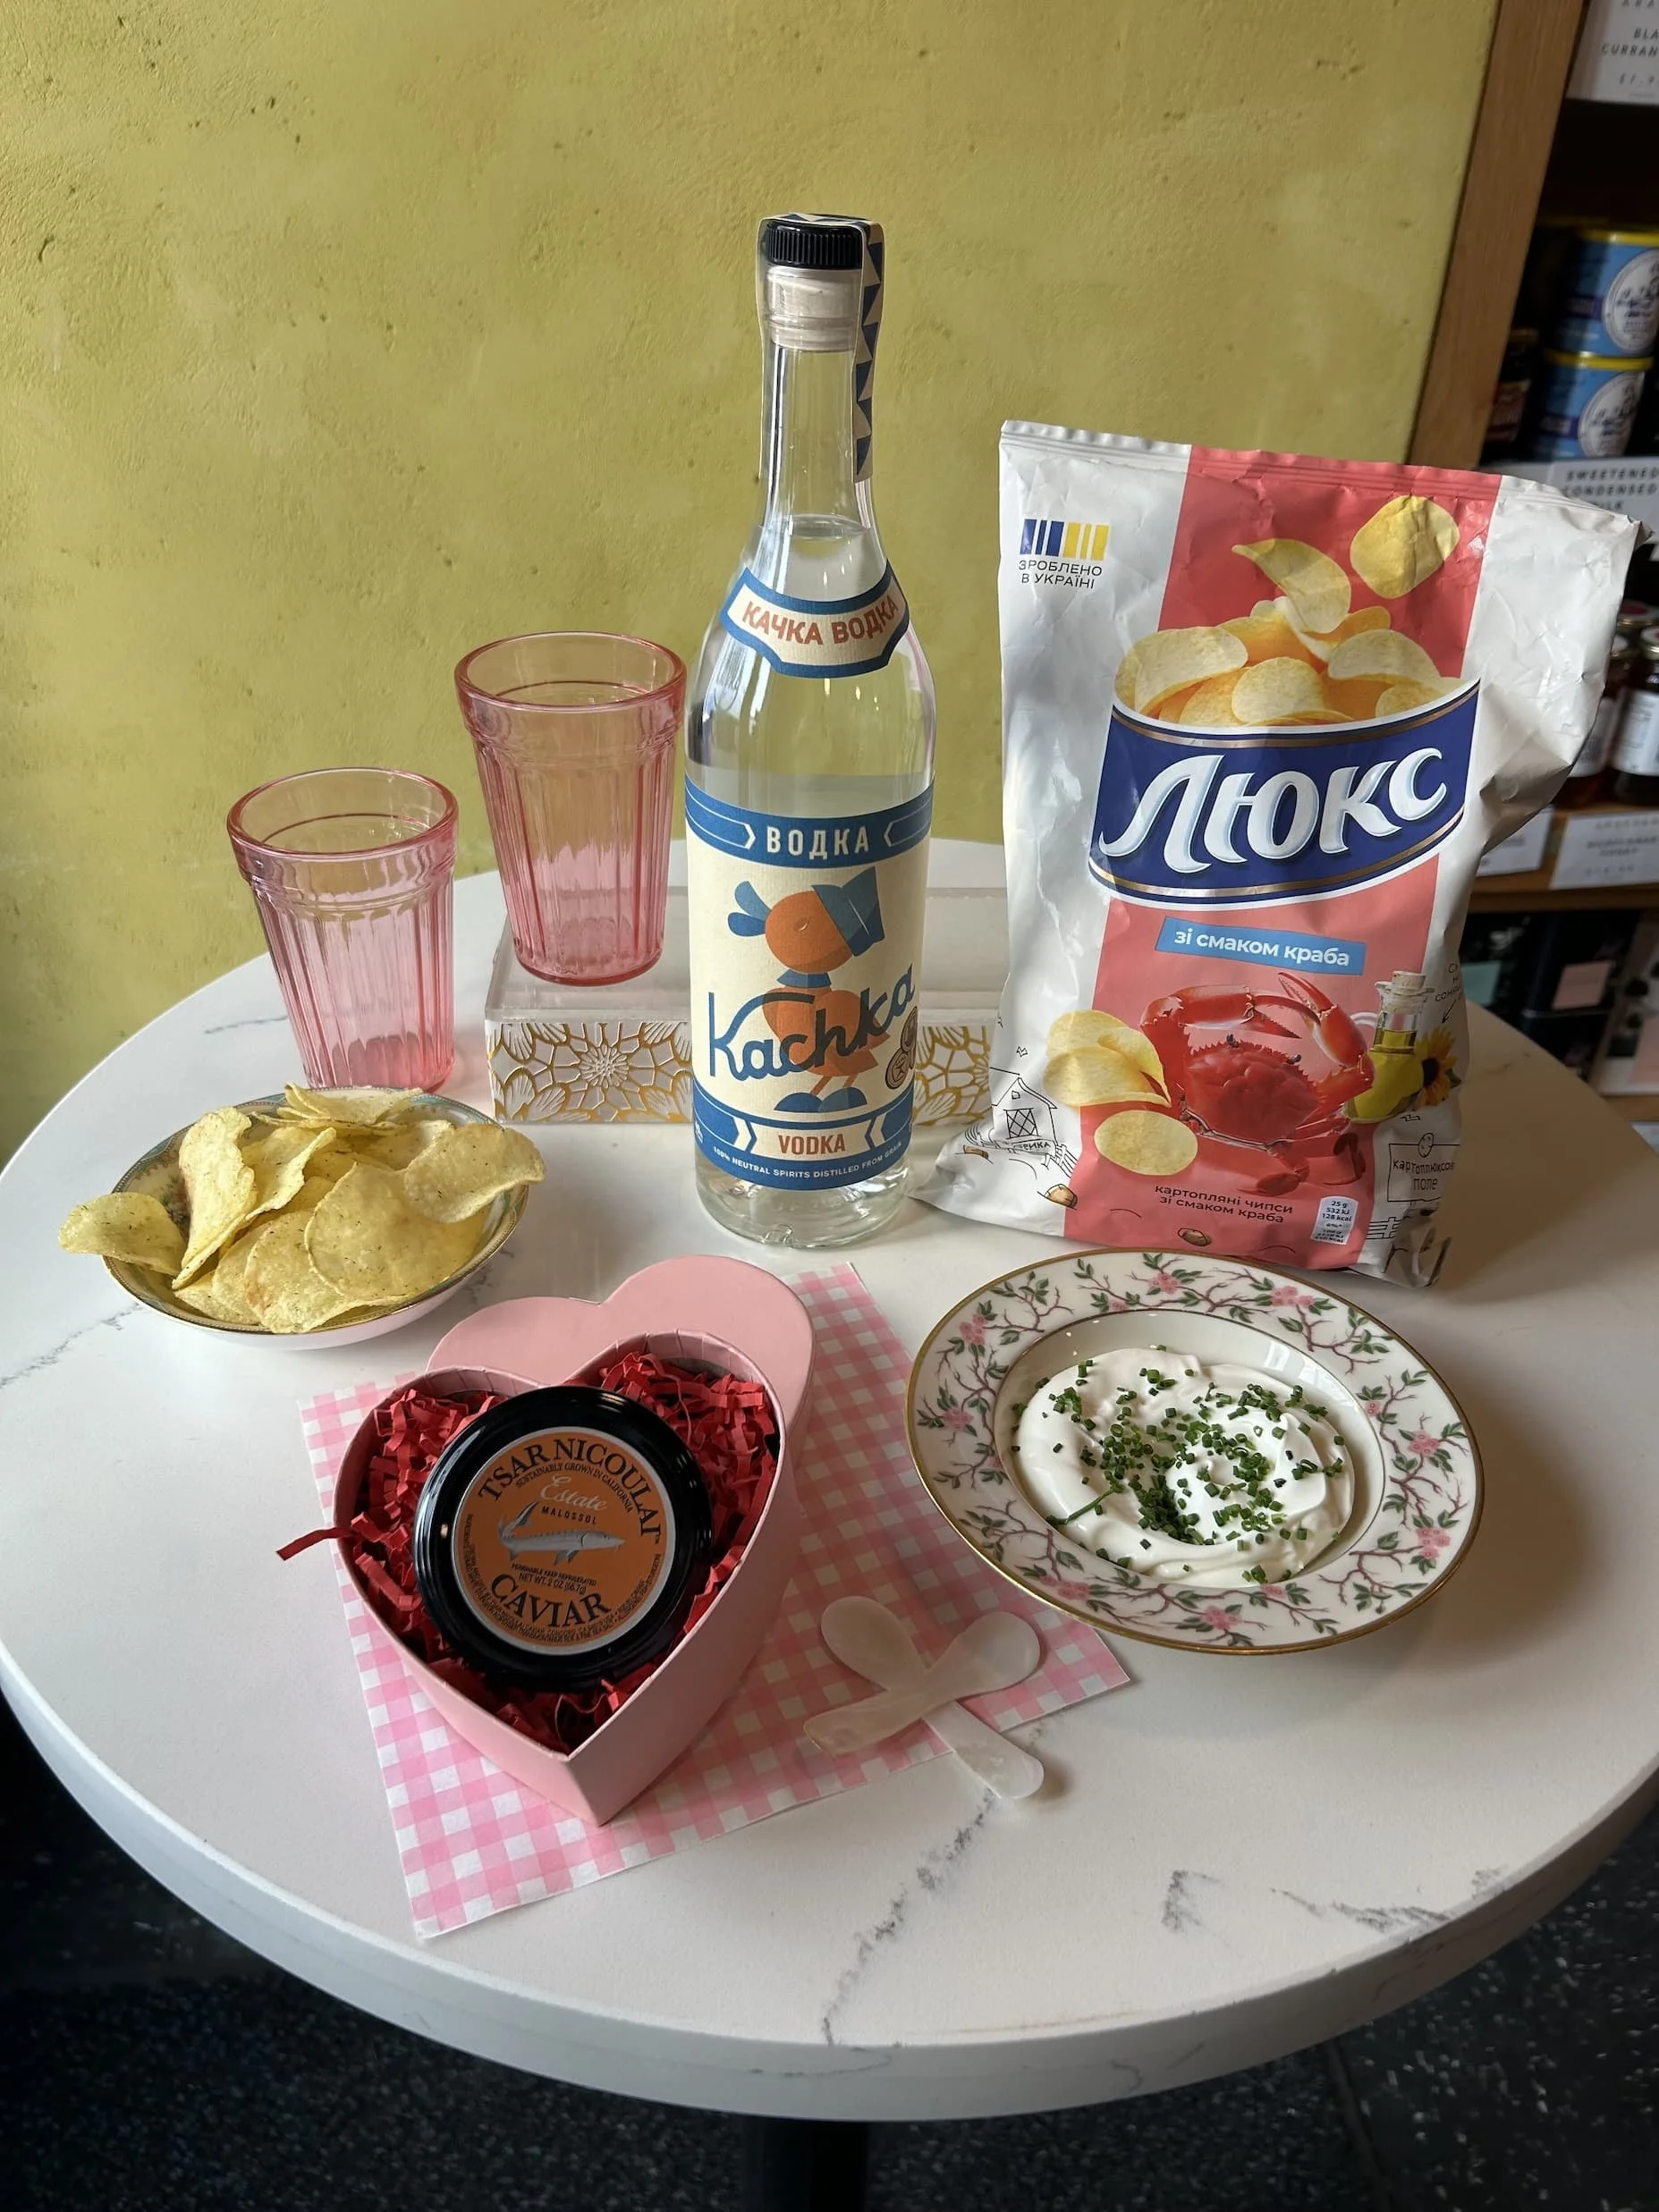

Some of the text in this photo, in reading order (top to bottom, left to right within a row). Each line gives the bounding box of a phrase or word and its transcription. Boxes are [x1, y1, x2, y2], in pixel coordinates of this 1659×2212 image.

[1566, 467, 1659, 481] SWEETENED
[1562, 484, 1657, 496] CONDENSED
[1019, 560, 1103, 577] ЗРОБЛЕНО
[1021, 573, 1095, 589] В УКРАЇНІ
[741, 595, 899, 645] КАЧКА ВОДКА
[766, 825, 868, 860] ВОДКА
[1174, 928, 1350, 967] зі смаком краба
[708, 963, 916, 1082] Kachka
[778, 1133, 846, 1155] VODKA
[714, 1146, 731, 1161] 100%
[732, 1158, 770, 1175] NEUTRAL
[773, 1169, 811, 1178] SPIRITS
[813, 1164, 859, 1178] DISTILLED
[861, 1155, 883, 1169] FROM
[1155, 1186, 1293, 1213] картопляні чипси
[1159, 1195, 1284, 1223] зі смаком краба
[478, 1444, 551, 1501] TSAR
[516, 1462, 634, 1513] SUSTAINABLY GROWN IN CALIFORNIA
[540, 1473, 608, 1511] Estate
[542, 1506, 597, 1524] MALOSSOL
[520, 1572, 534, 1583] NET
[554, 1579, 563, 1589] OZ
[491, 1574, 612, 1626] CAVIAR
